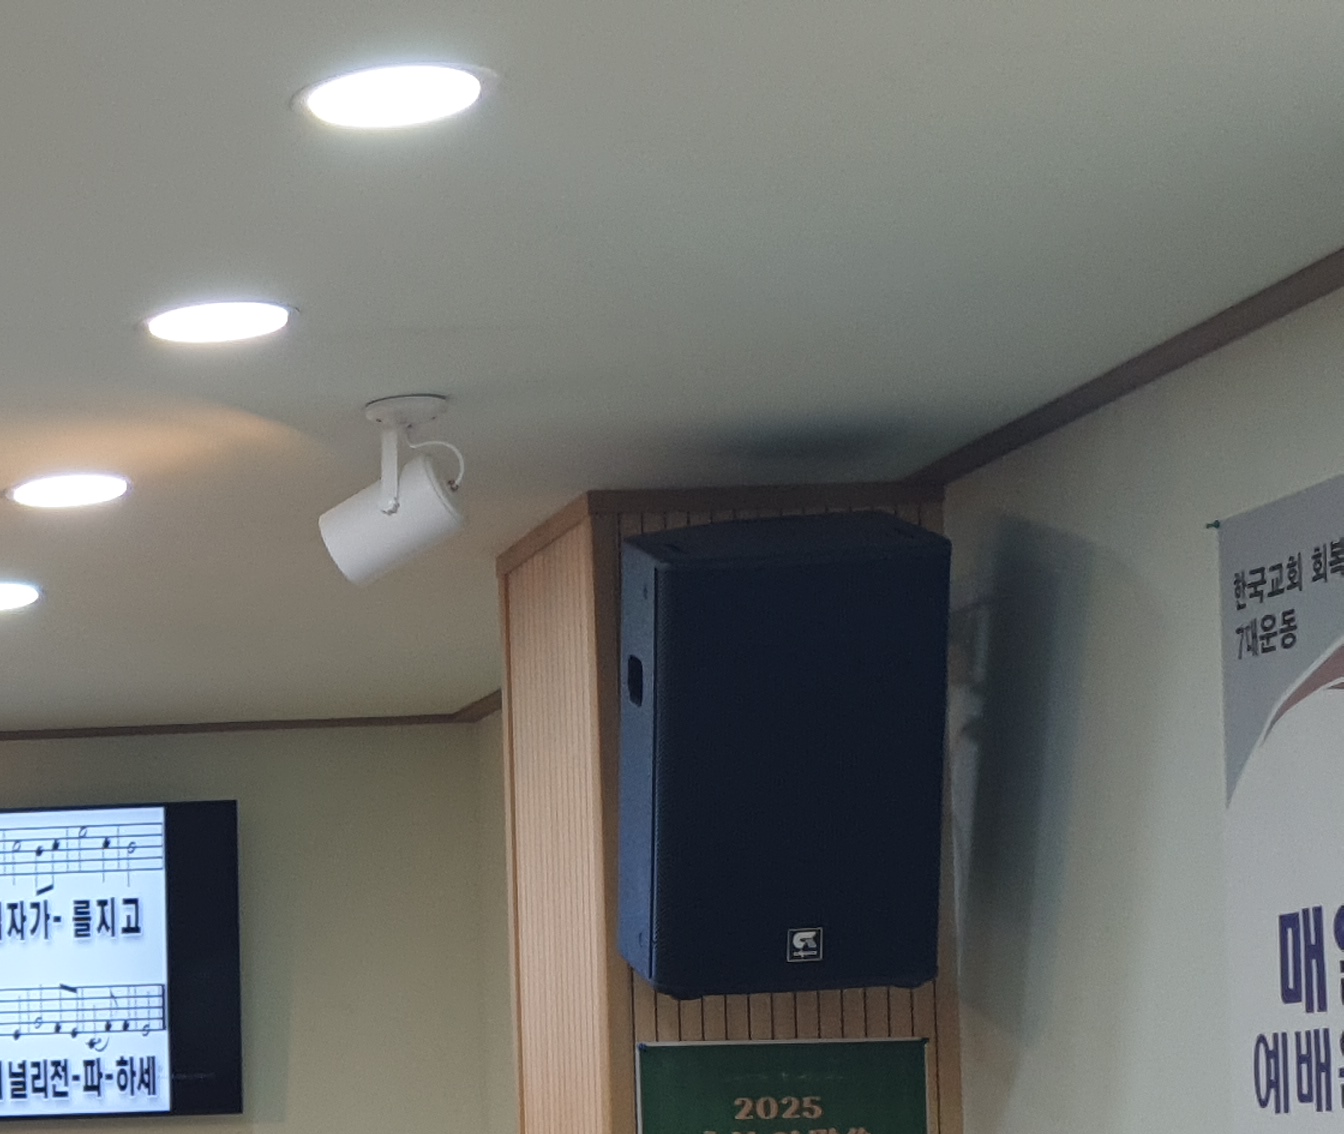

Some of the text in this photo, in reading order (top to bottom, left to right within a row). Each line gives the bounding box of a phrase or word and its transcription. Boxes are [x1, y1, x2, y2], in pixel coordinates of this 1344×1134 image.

[1234, 551, 1302, 610] 한국교회
[1235, 608, 1298, 660] 7대운동
[1253, 1027, 1344, 1115] 예배
[733, 1096, 824, 1121] 2025
